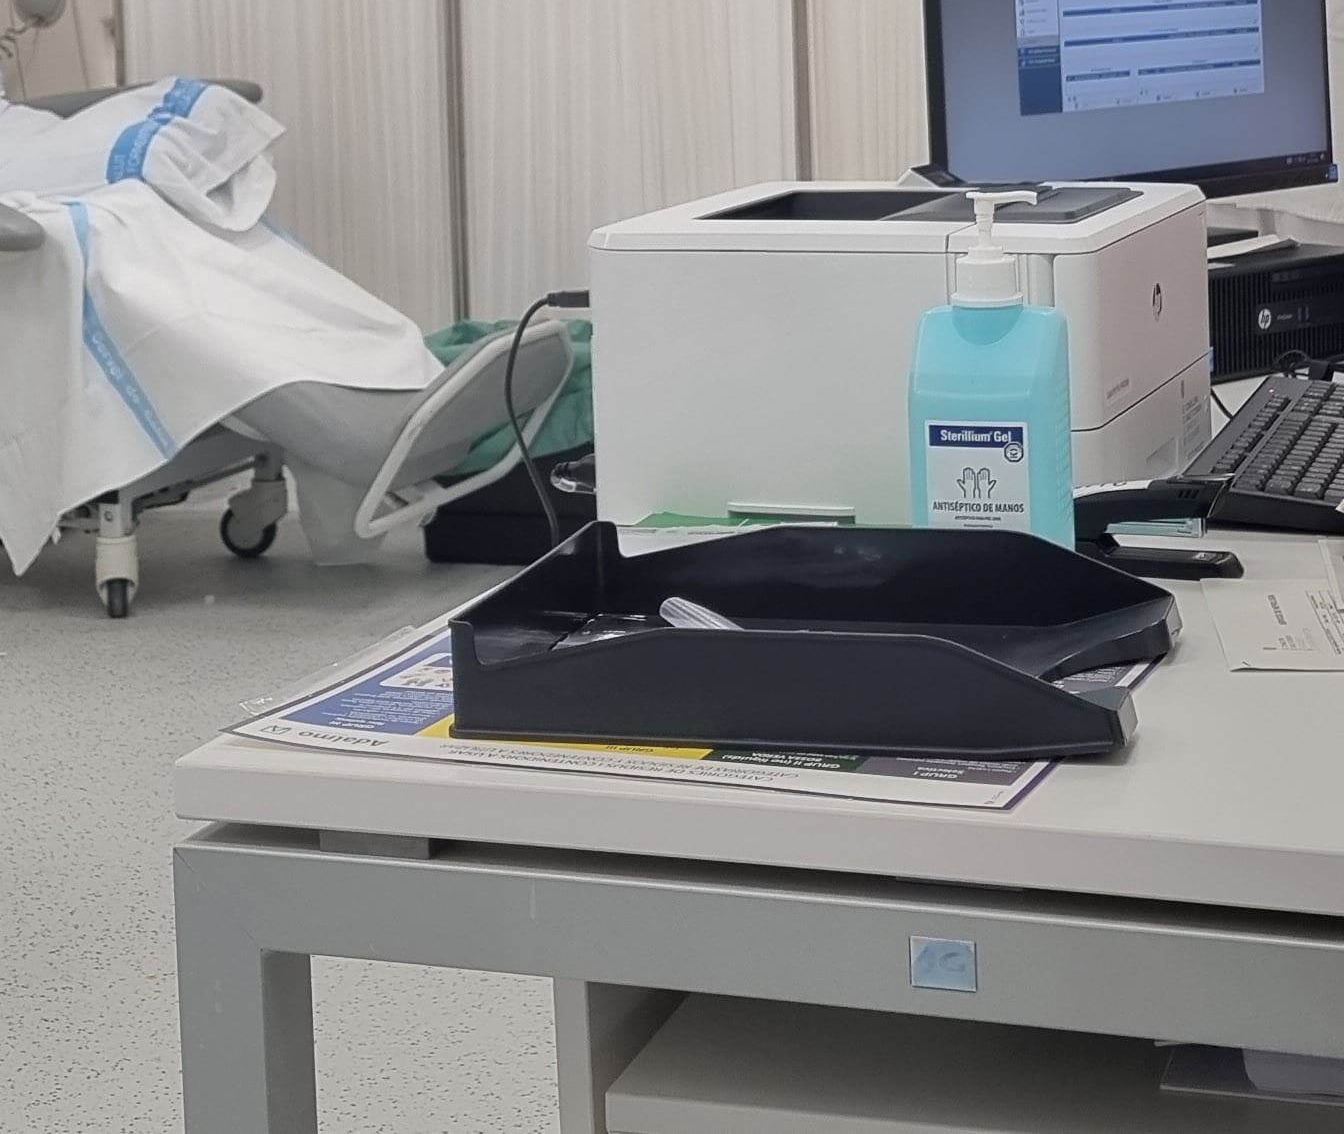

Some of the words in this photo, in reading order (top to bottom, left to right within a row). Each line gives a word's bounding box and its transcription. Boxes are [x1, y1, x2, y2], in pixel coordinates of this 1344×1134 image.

[993, 430, 1012, 443] Gel
[932, 500, 982, 513] ANTISÉPTICO
[983, 502, 993, 513] DE
[995, 503, 1024, 513] MANOS
[298, 731, 389, 747] Adalmo
[803, 761, 841, 769] GRUP
[918, 771, 959, 779] GRUP
